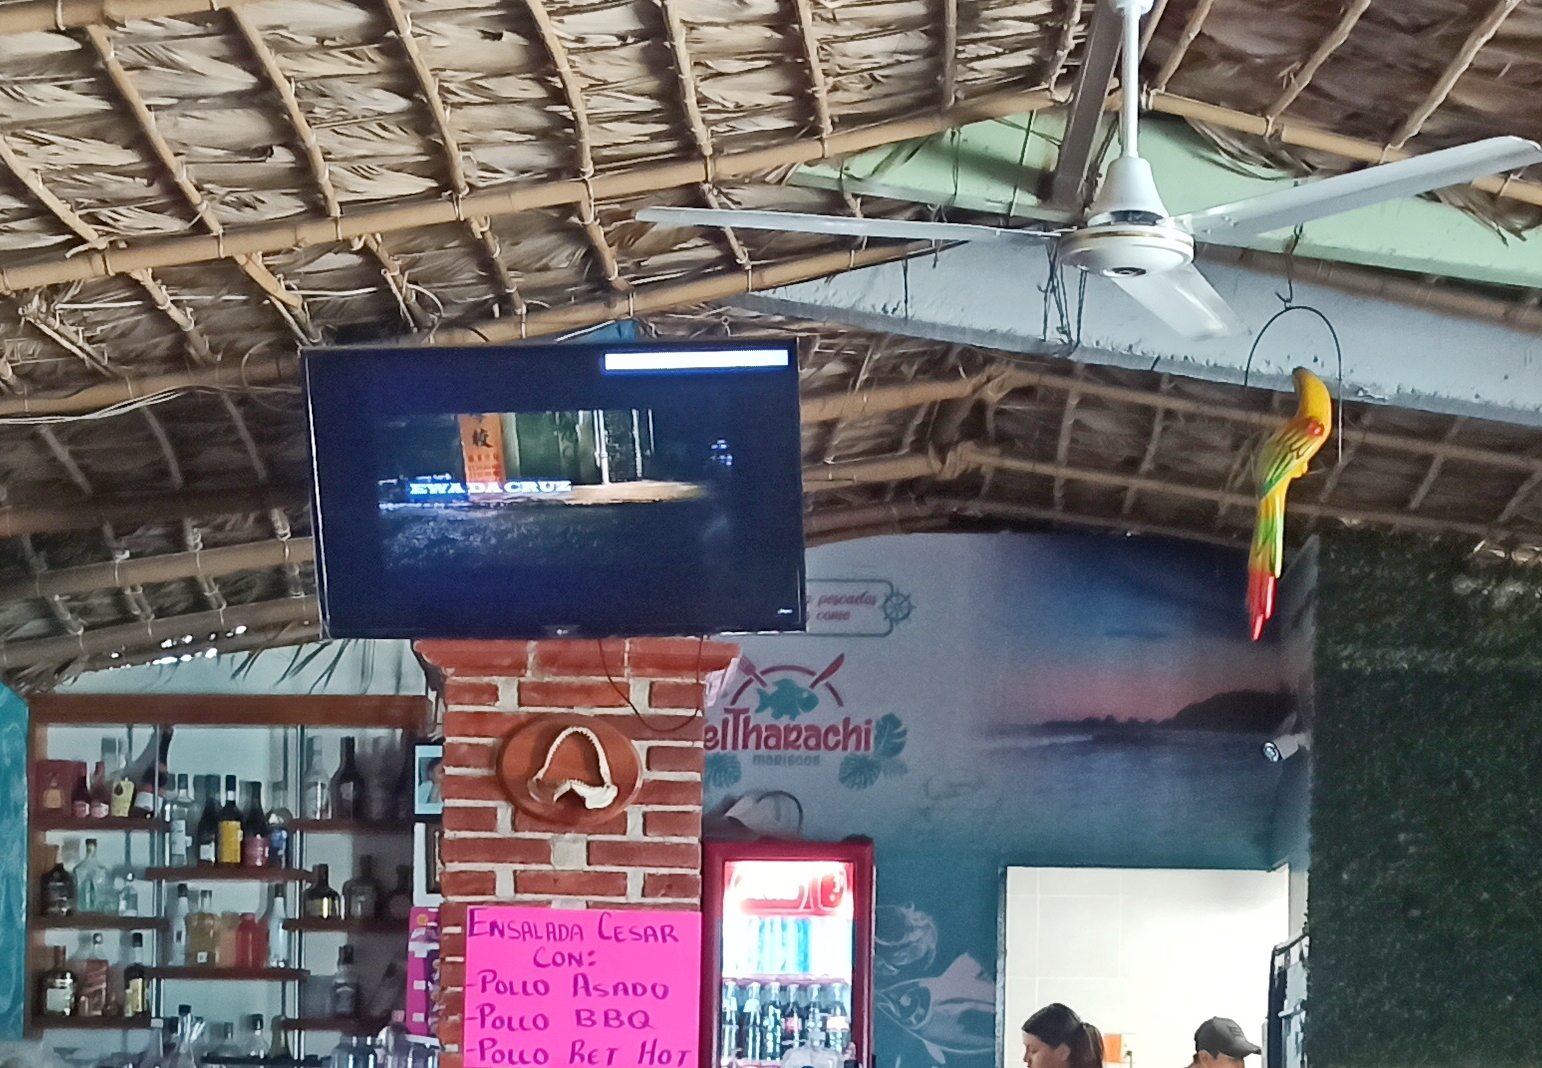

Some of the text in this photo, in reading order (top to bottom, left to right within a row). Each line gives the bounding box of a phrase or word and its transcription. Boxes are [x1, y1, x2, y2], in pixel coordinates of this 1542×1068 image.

[410, 480, 572, 495] EWA DA CRUZ
[468, 907, 680, 944] ENSALADA CESAR
[532, 946, 597, 968] CON:
[571, 971, 670, 1000] ASADO
[574, 1008, 658, 1030] BBQ
[637, 1037, 693, 1068] HOT
